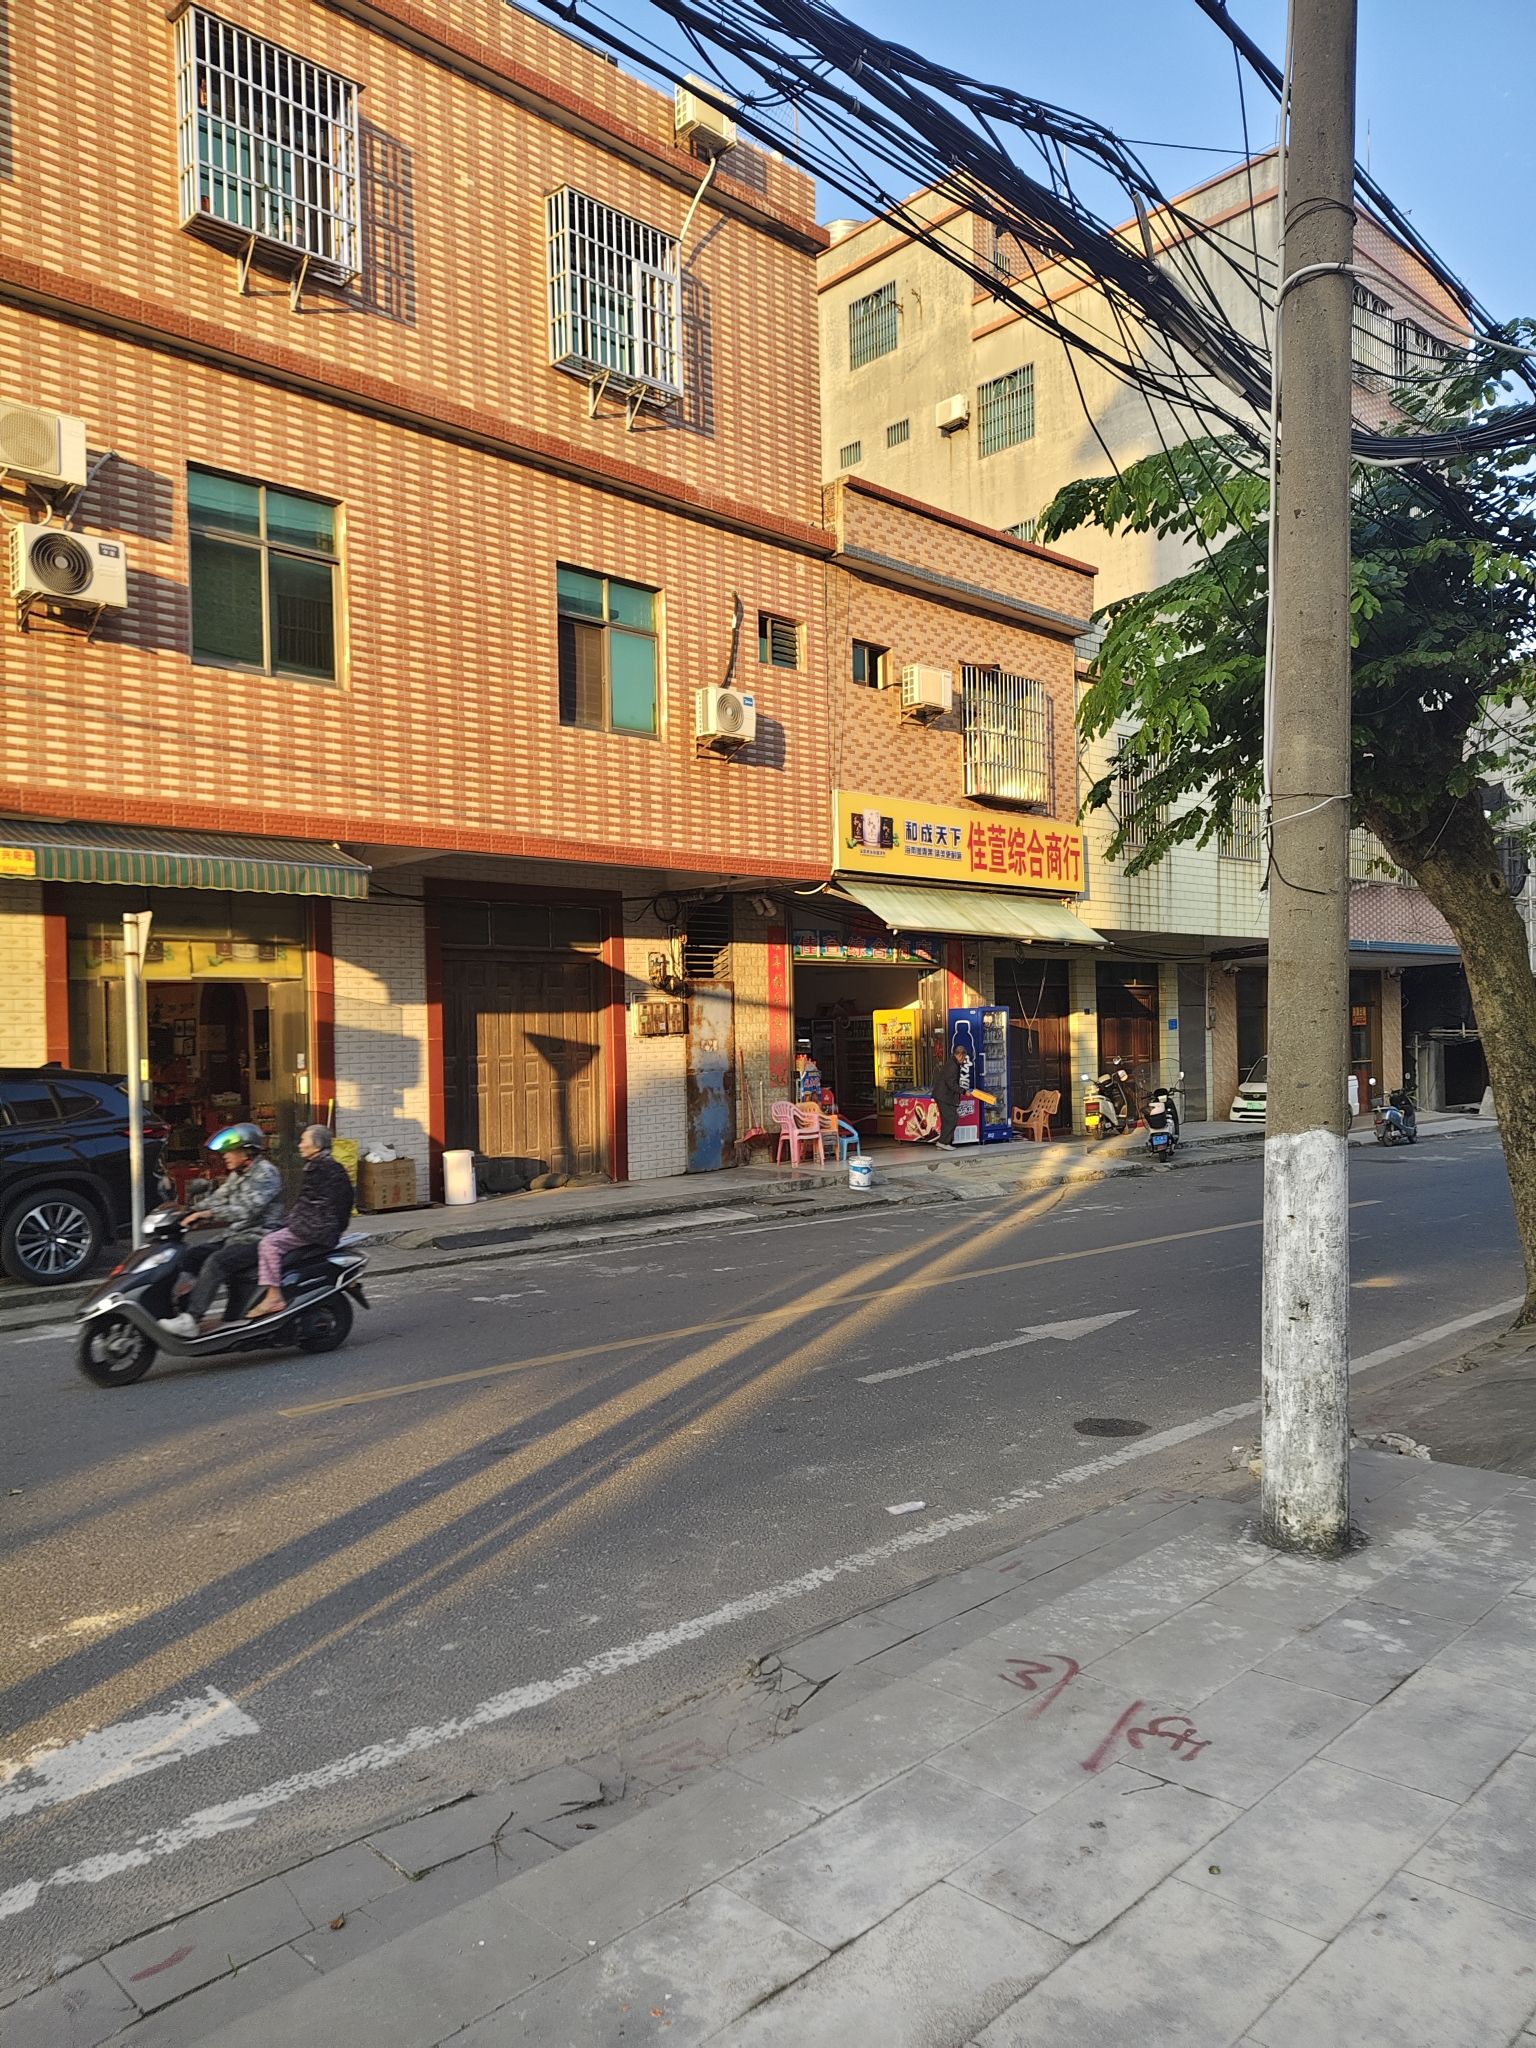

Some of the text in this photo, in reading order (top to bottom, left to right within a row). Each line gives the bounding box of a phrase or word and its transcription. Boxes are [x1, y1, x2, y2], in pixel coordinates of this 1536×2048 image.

[904, 820, 962, 846] 和成天下
[967, 820, 1081, 882] 佳萱综合商行
